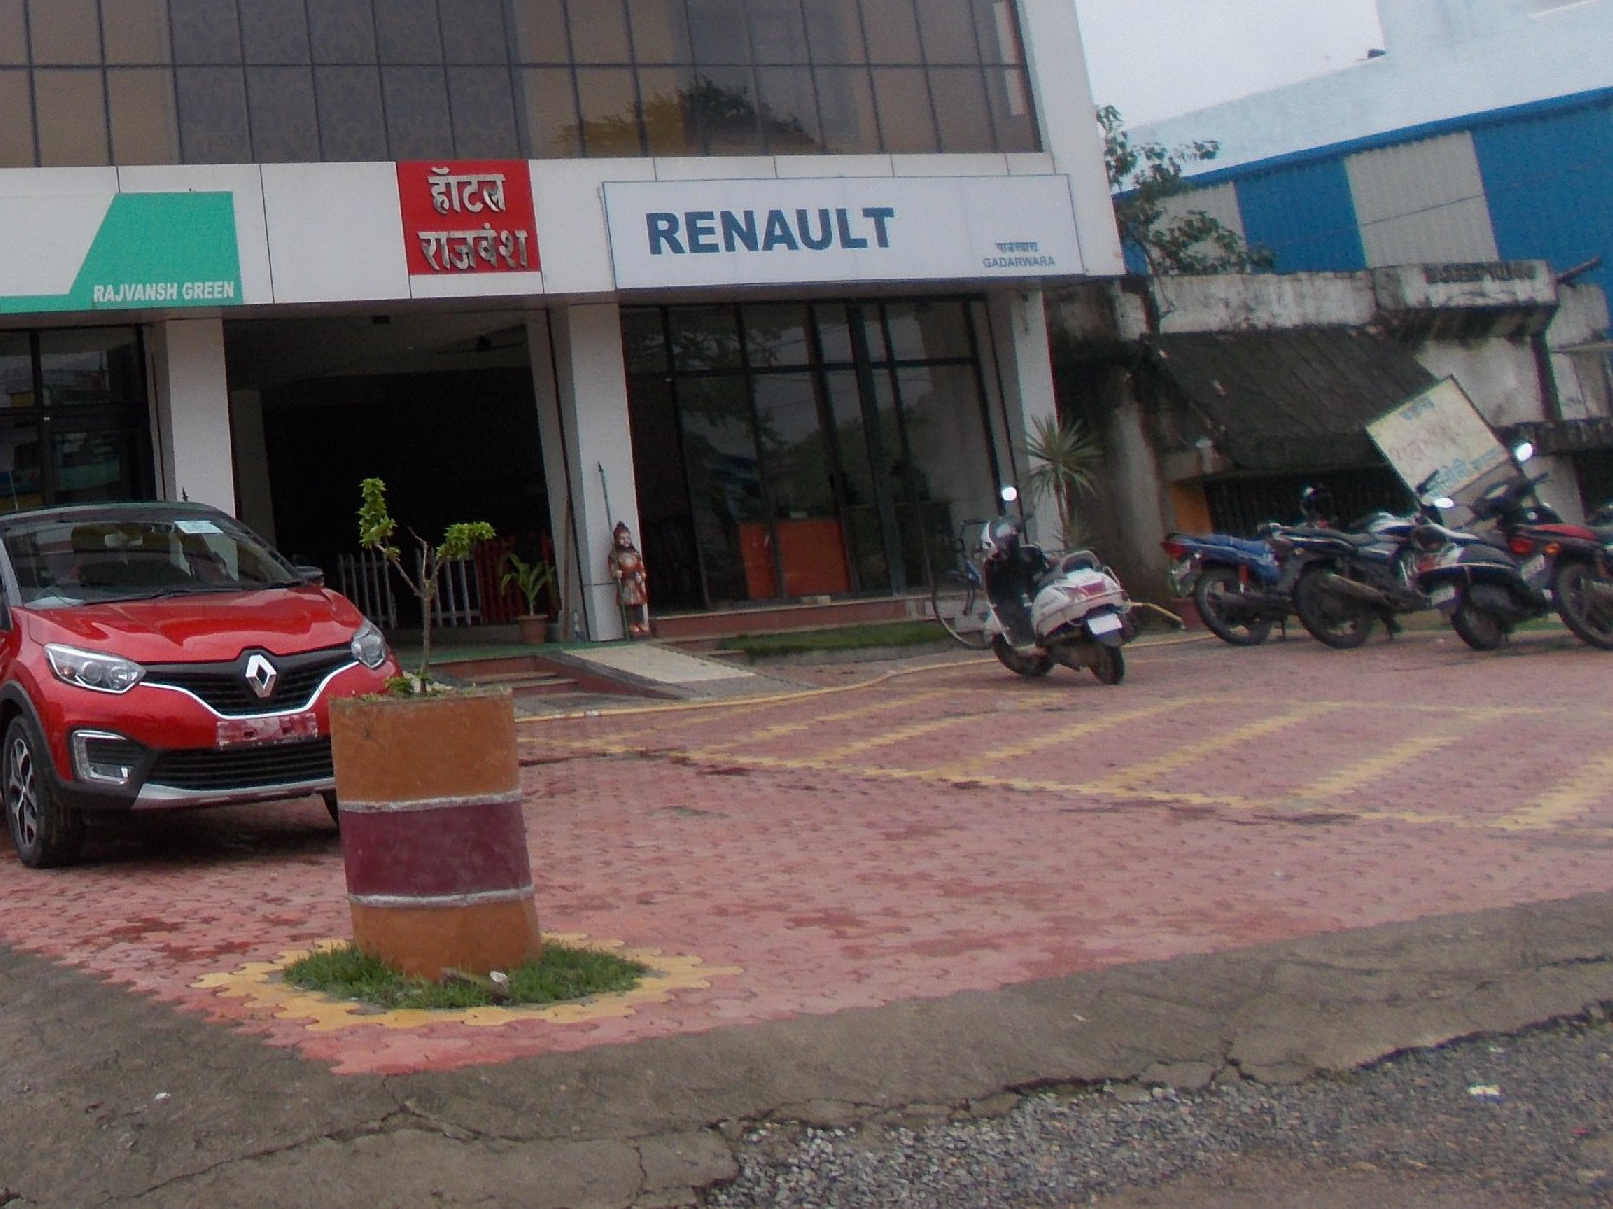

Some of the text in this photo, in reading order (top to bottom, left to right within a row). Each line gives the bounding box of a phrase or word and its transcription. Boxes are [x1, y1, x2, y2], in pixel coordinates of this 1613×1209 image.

[417, 222, 528, 270] राजवंश
[645, 207, 895, 255] RENAULT
[982, 256, 1056, 268] GADARWARA
[93, 280, 234, 303] RAJVANSH GREEN
